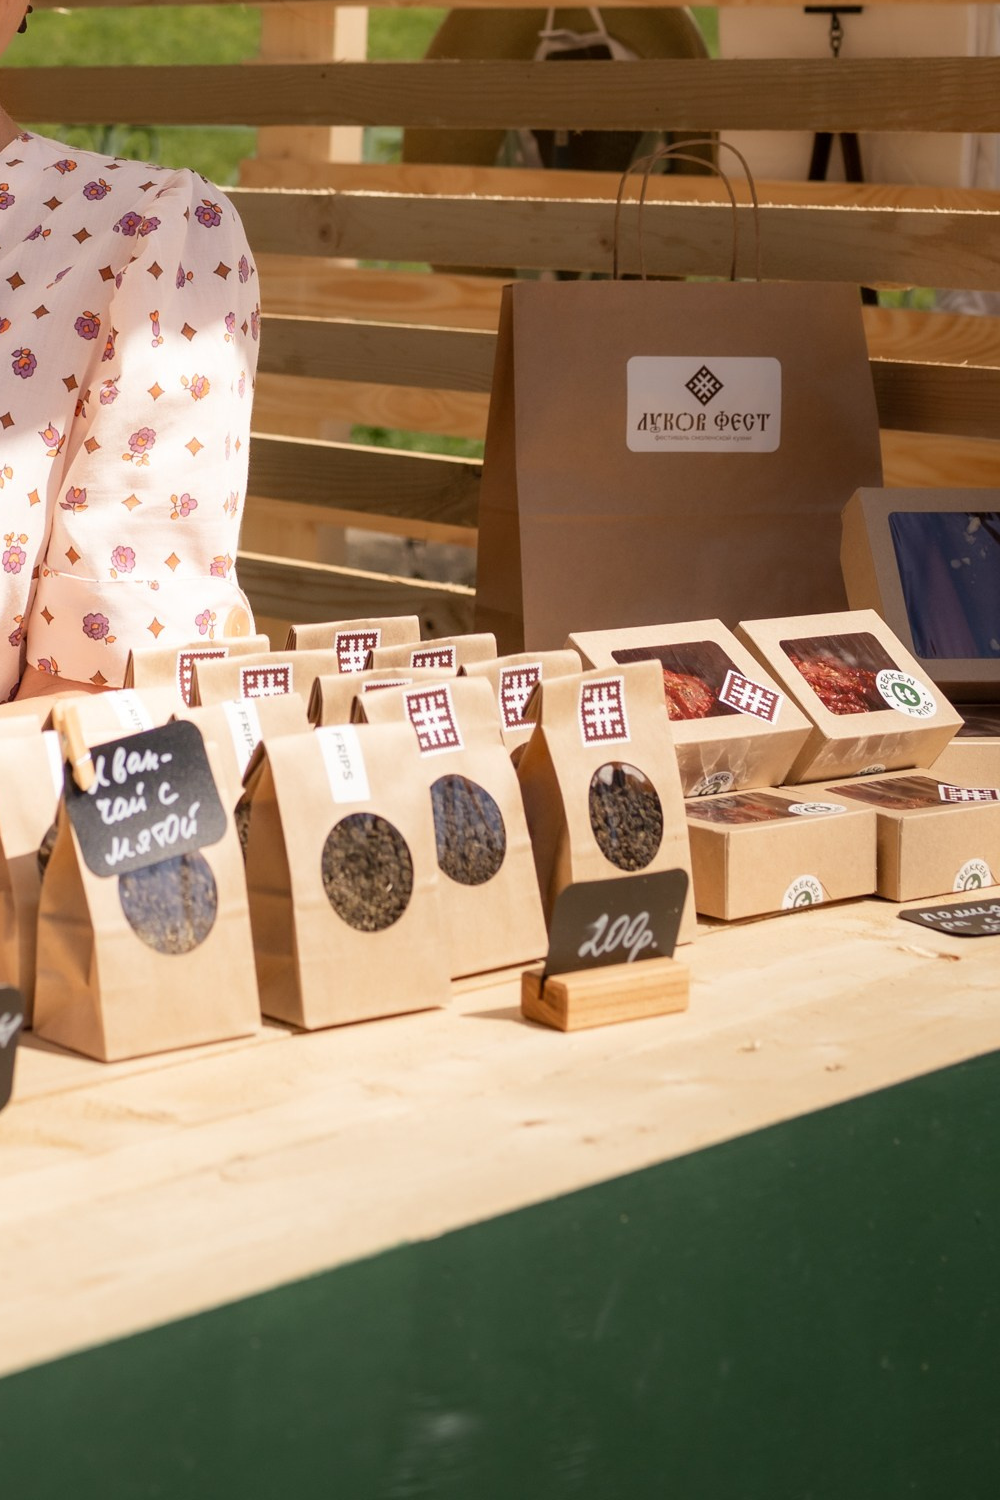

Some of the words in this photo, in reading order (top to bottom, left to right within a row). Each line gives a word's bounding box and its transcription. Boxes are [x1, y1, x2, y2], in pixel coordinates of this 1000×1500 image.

[714, 411, 771, 431] ФЕСТ
[880, 673, 915, 698] FREKKEN
[908, 701, 933, 716] FRIPS
[333, 732, 353, 780] FRIPS
[96, 781, 147, 825] чай
[158, 781, 179, 806] с
[104, 801, 200, 866] мятой
[956, 863, 988, 889] FREKKEN
[787, 879, 820, 902] FREKKEN
